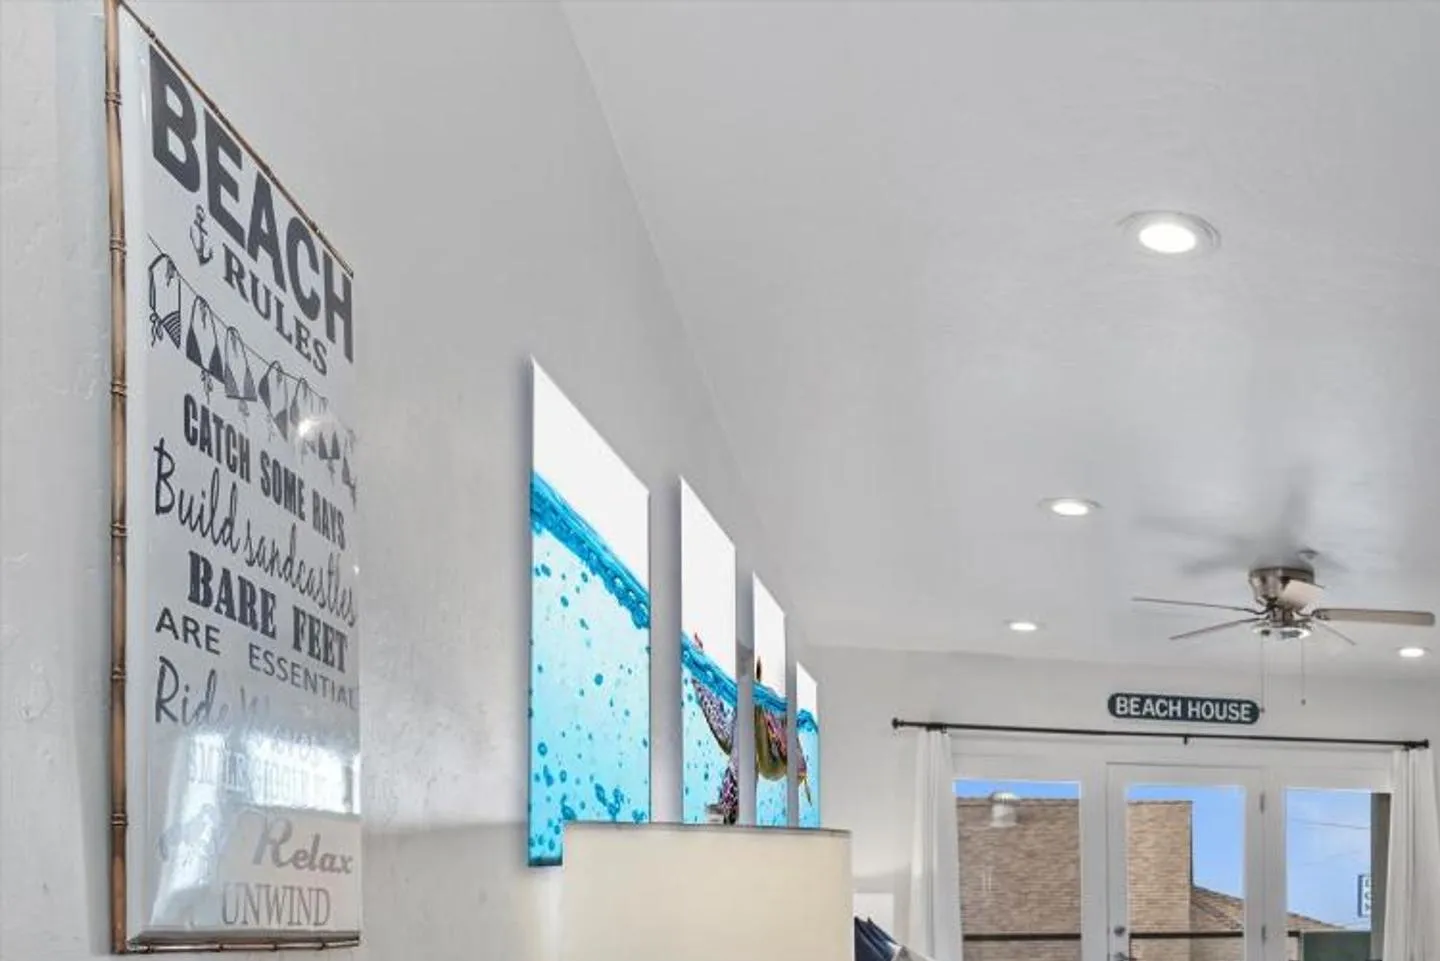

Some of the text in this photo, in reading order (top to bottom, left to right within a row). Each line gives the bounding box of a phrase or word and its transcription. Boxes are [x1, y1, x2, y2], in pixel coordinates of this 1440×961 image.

[148, 44, 354, 364] BEACH
[221, 242, 328, 377] RULES
[184, 393, 346, 551] CATCH SOME RAYS
[154, 437, 357, 630] Build sandcastles
[155, 607, 221, 656] ARE
[187, 550, 349, 674] BARE FEET
[154, 655, 231, 726] Ride
[1115, 696, 1253, 722] BEACH HOUSE
[246, 809, 354, 876] Relax
[220, 880, 332, 927] UNWIND
